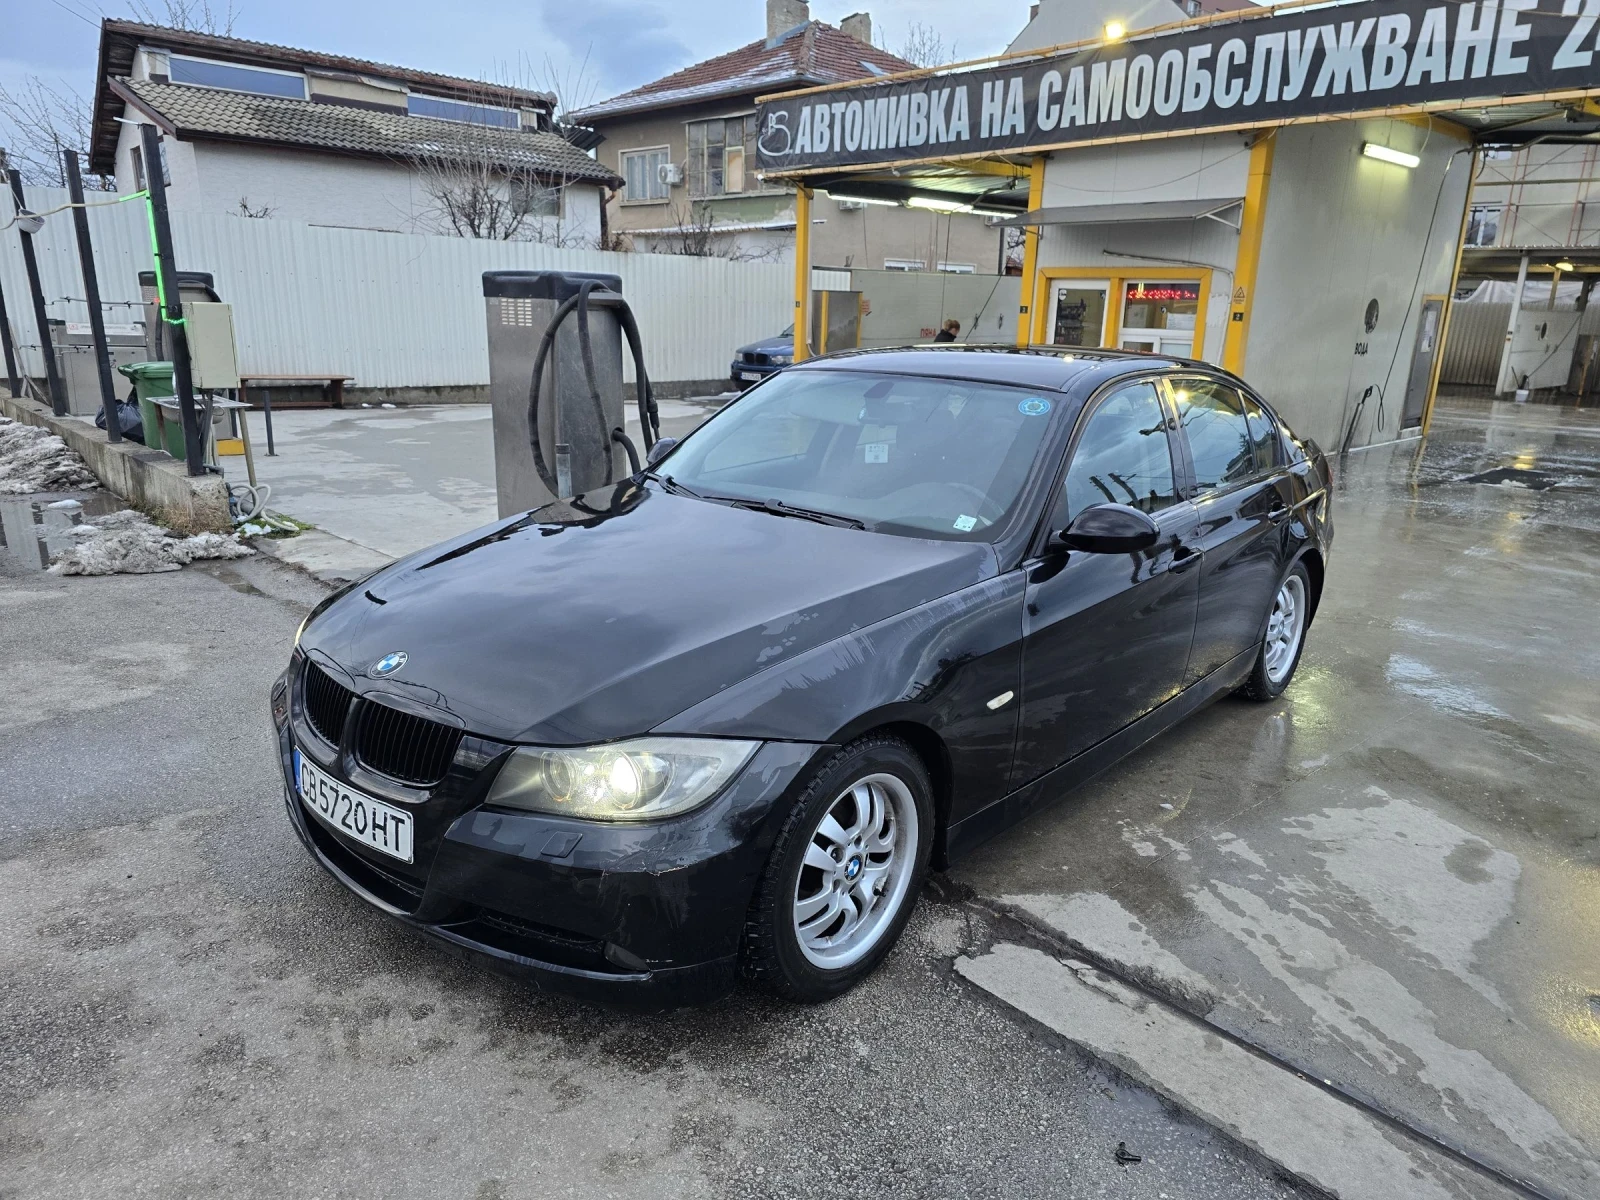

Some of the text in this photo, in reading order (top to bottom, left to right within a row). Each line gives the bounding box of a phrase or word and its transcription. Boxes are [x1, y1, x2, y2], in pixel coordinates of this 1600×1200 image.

[795, 85, 969, 154] АВТОМИВКА
[980, 77, 1026, 139] НА
[1037, 0, 1540, 131] САМООБСЛУЖВАНЕ
[1552, 0, 1600, 70] 2
